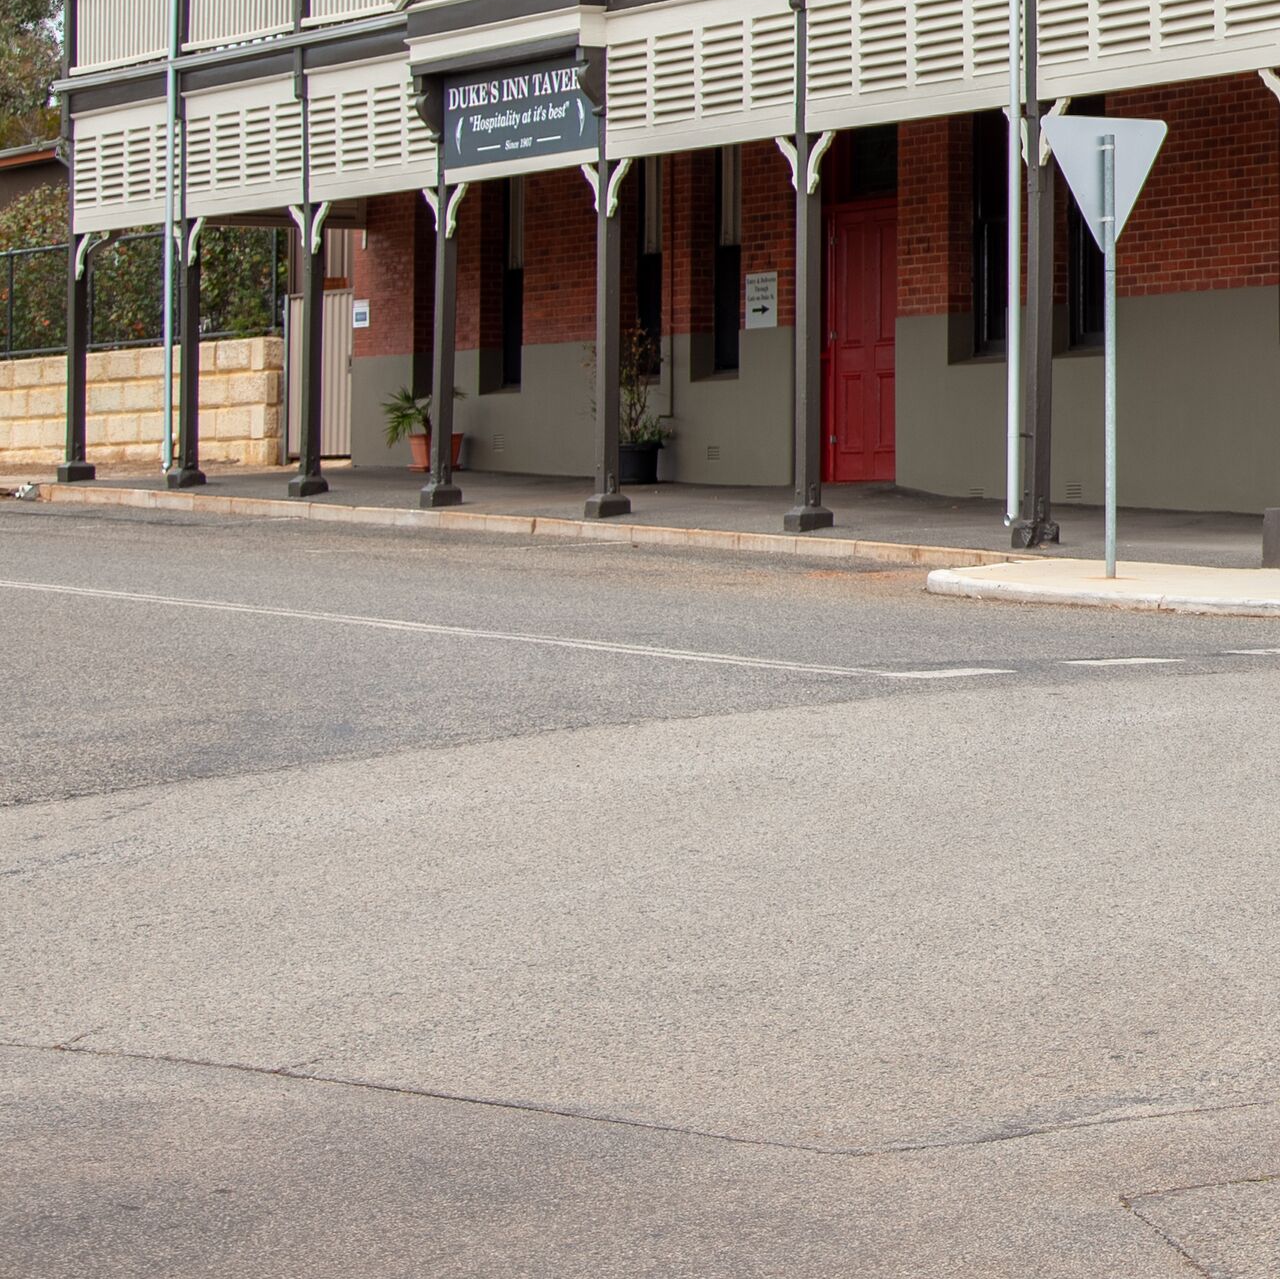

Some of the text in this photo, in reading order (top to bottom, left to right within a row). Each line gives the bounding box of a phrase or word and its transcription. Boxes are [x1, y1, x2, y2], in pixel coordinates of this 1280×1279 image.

[448, 67, 581, 110] DUKE'S INN TAVER
[521, 108, 532, 124] at
[533, 105, 547, 121] it's
[504, 137, 533, 151] Since 1907
